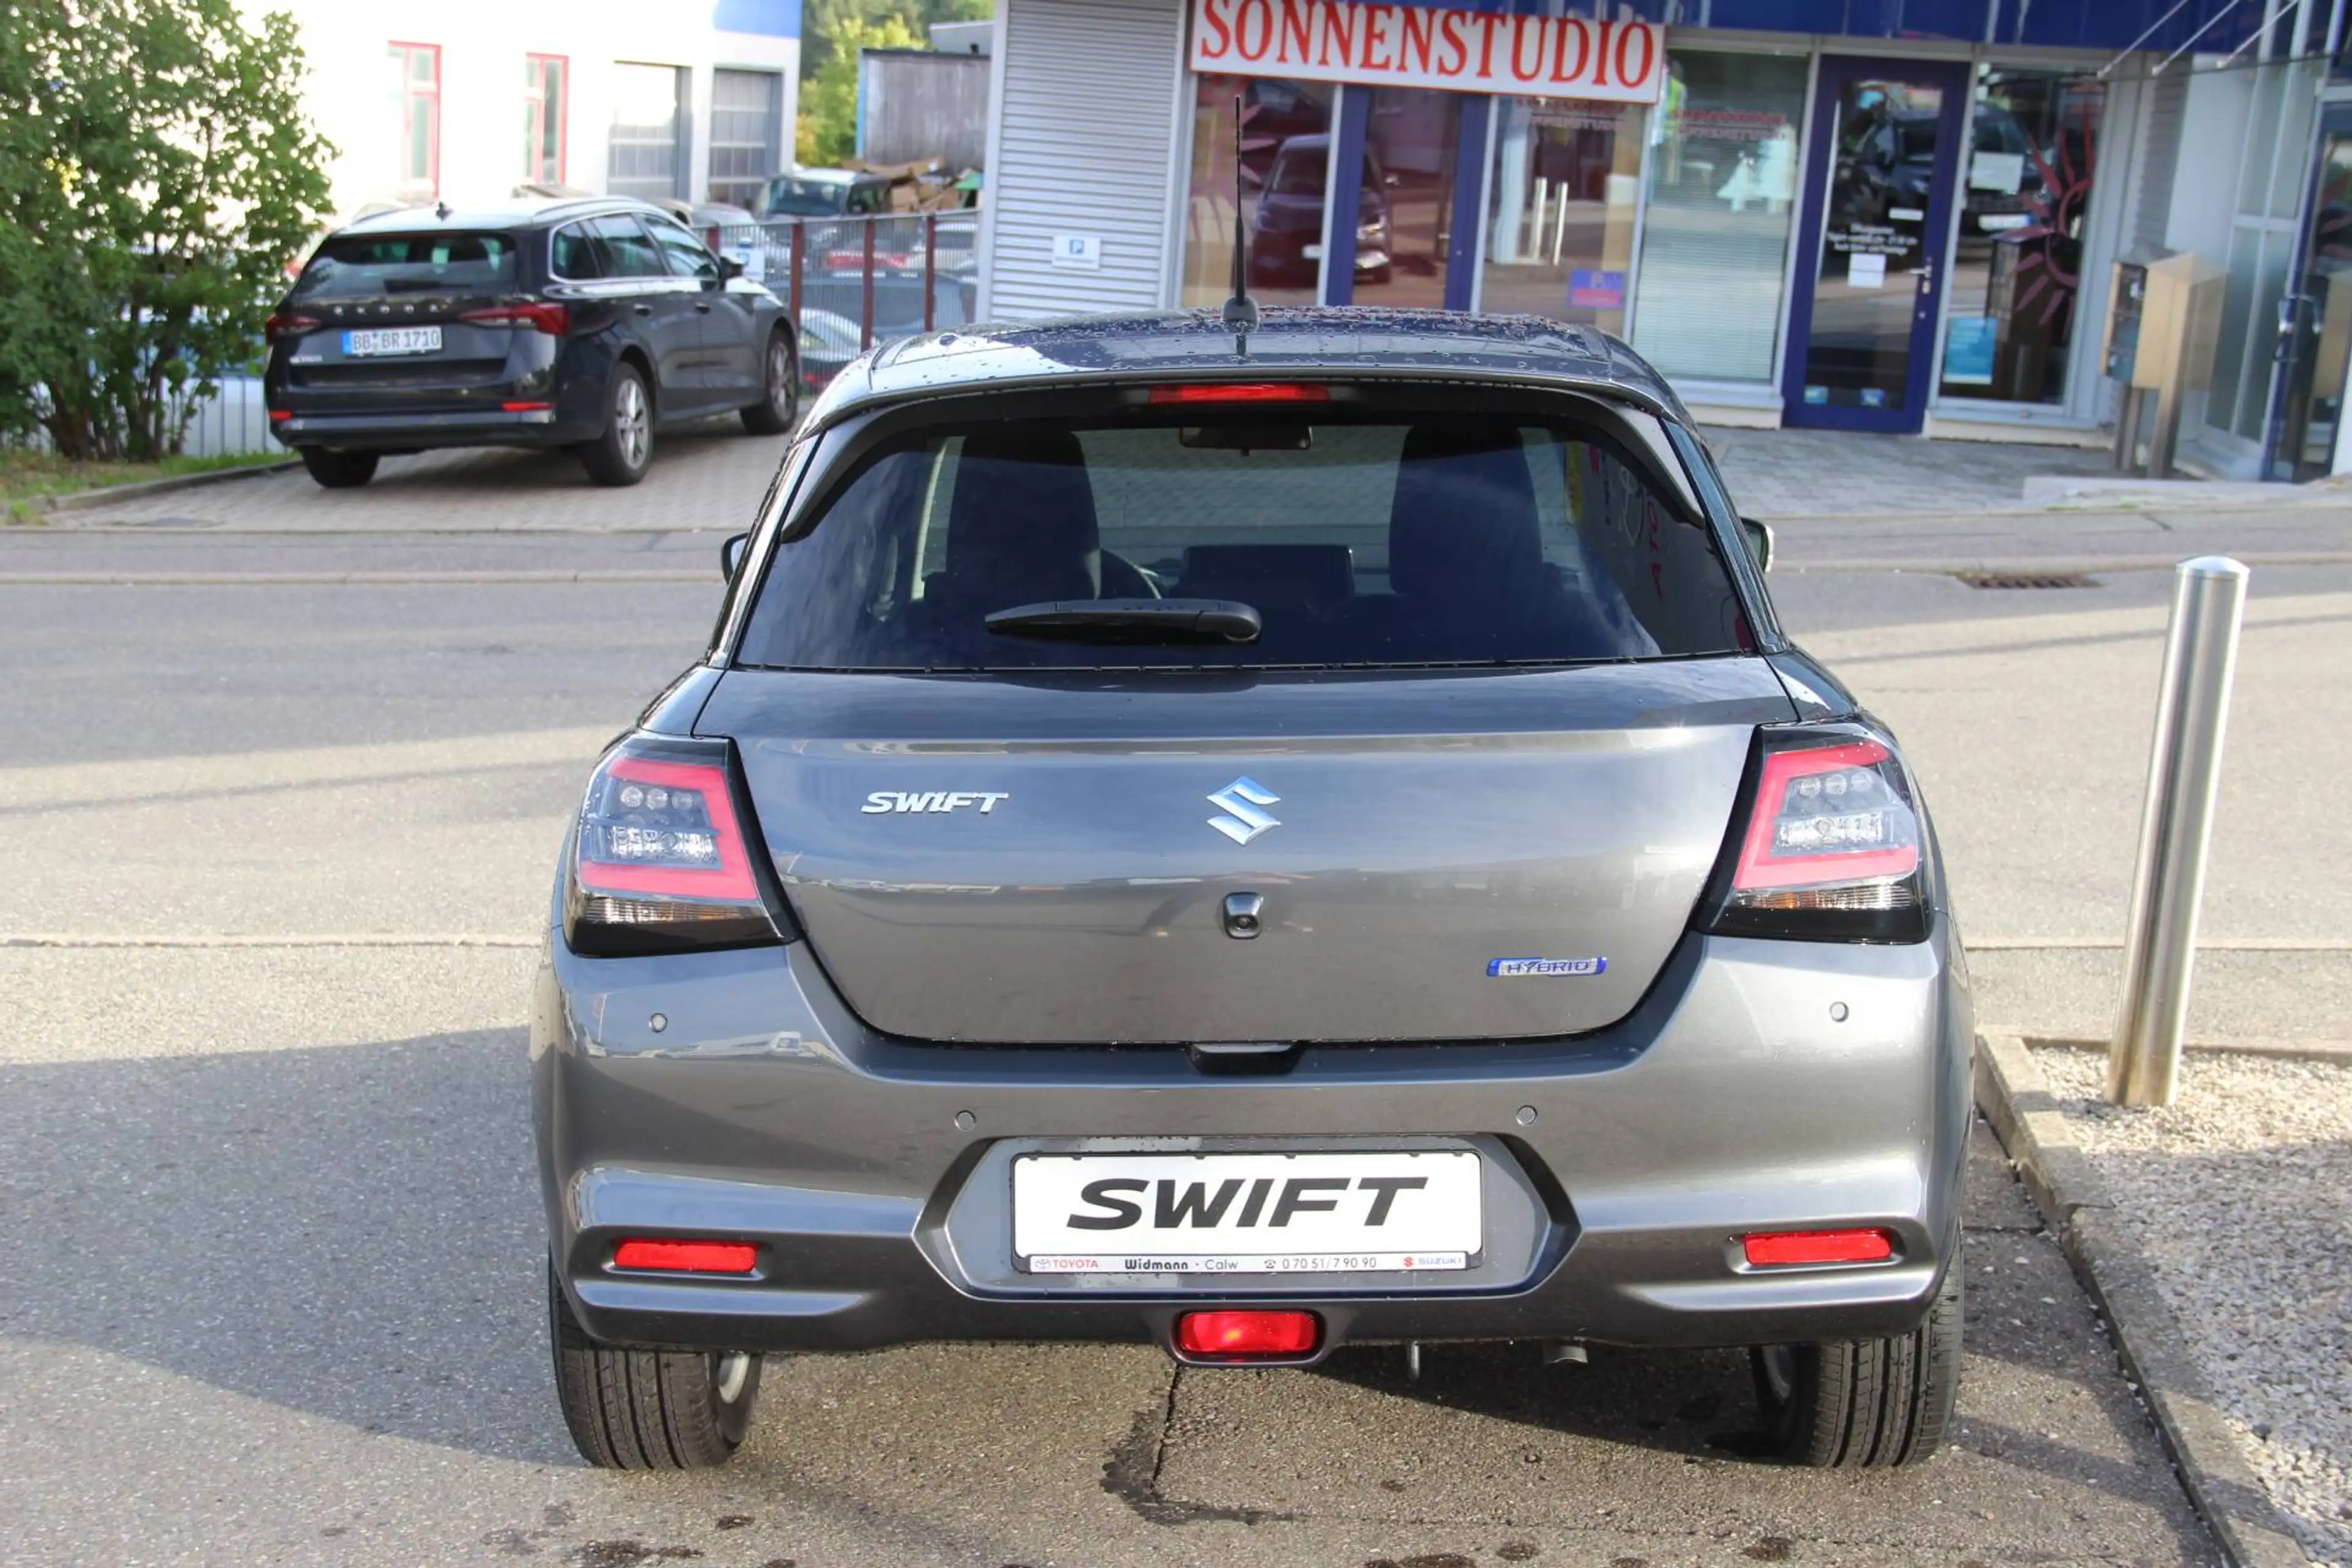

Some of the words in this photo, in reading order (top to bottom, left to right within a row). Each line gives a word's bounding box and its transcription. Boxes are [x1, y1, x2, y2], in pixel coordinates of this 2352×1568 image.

[1200, 0, 1654, 89] SONNENSTUDIO
[404, 330, 440, 347] 1710
[861, 792, 1009, 813] SWIFT
[1507, 961, 1589, 973] HYBRID
[1066, 1177, 1429, 1231] SWIFT
[1052, 1259, 1099, 1268] TOYOTA
[1125, 1259, 1188, 1270] Widmann
[1205, 1259, 1239, 1270] Calw
